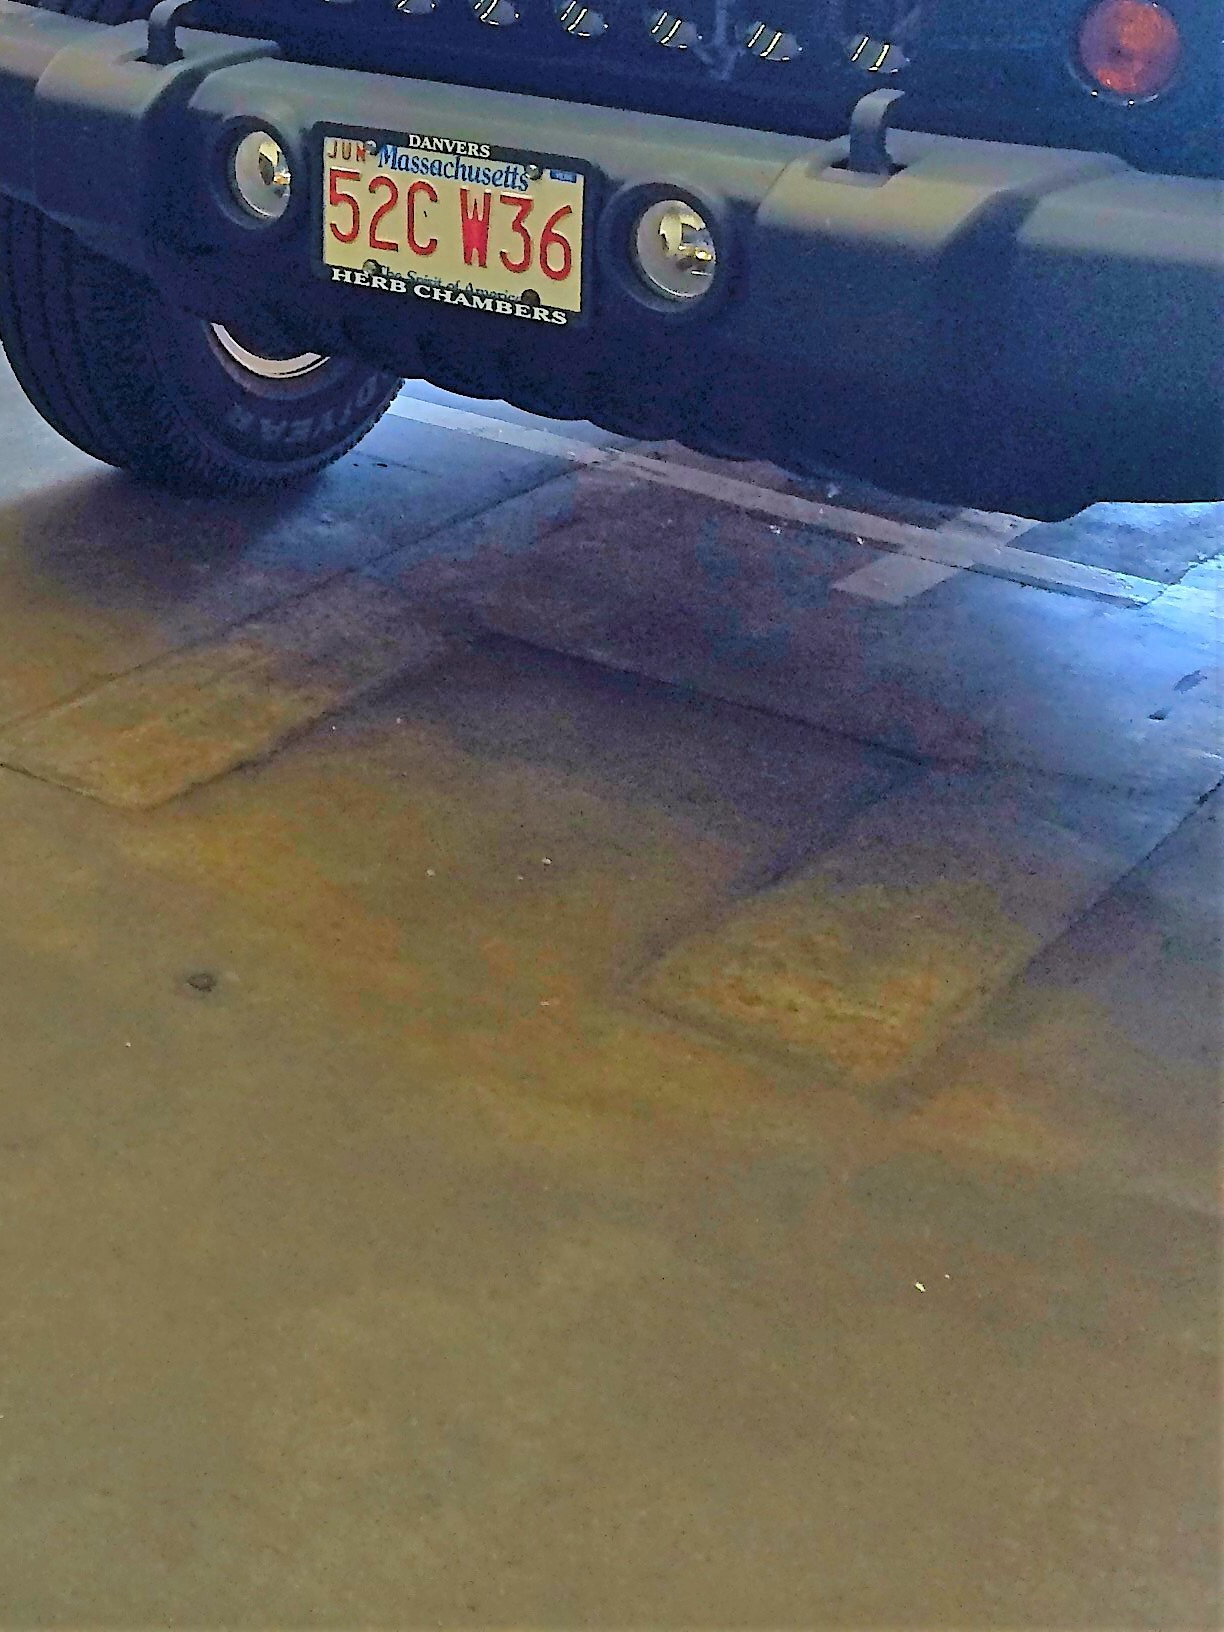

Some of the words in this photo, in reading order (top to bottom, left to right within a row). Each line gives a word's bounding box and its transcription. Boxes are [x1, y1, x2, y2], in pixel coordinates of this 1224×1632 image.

[327, 141, 366, 162] JUN
[378, 143, 530, 192] Massachusetts
[408, 134, 492, 159] DANVERS
[328, 166, 439, 257] 52C
[458, 184, 575, 282] W36
[331, 267, 407, 294] HERB
[412, 283, 568, 325] CHAMBERS
